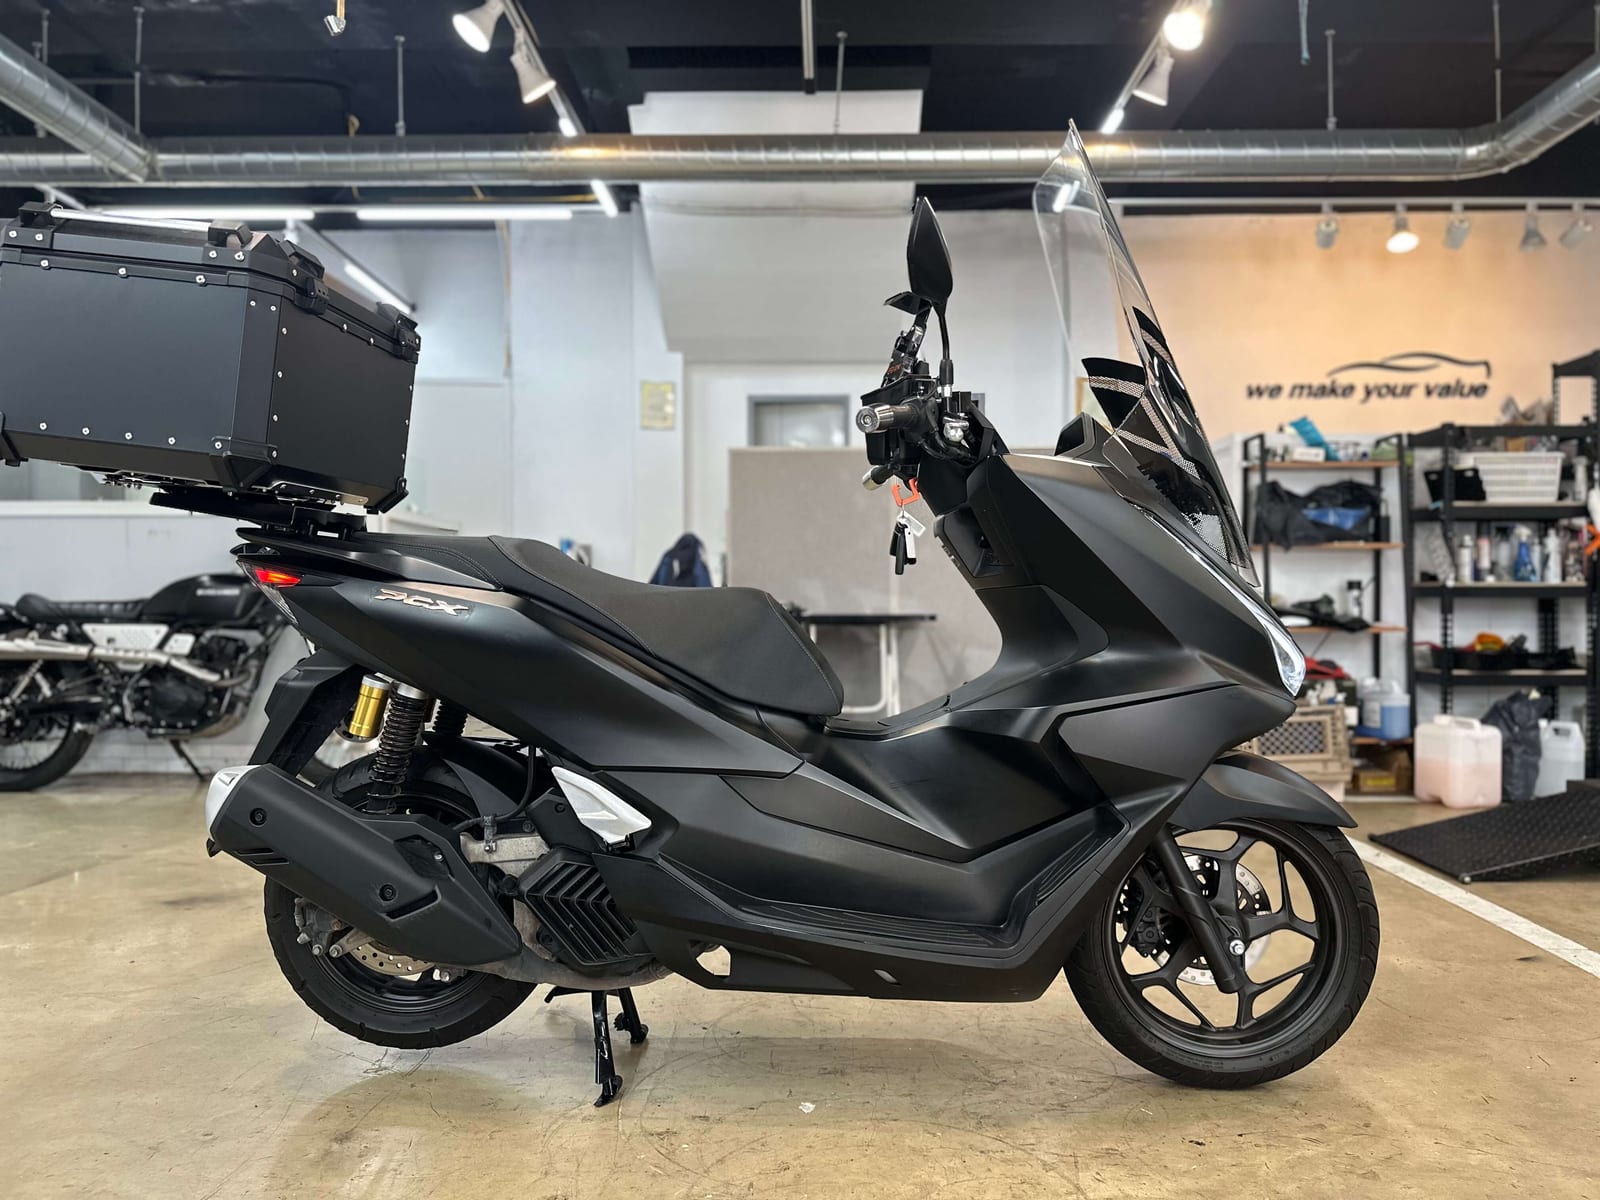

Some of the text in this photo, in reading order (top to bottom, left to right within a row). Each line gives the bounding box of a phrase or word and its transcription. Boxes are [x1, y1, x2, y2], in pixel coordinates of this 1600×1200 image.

[1246, 379, 1488, 404] we make your value
[373, 588, 469, 616] PCX
